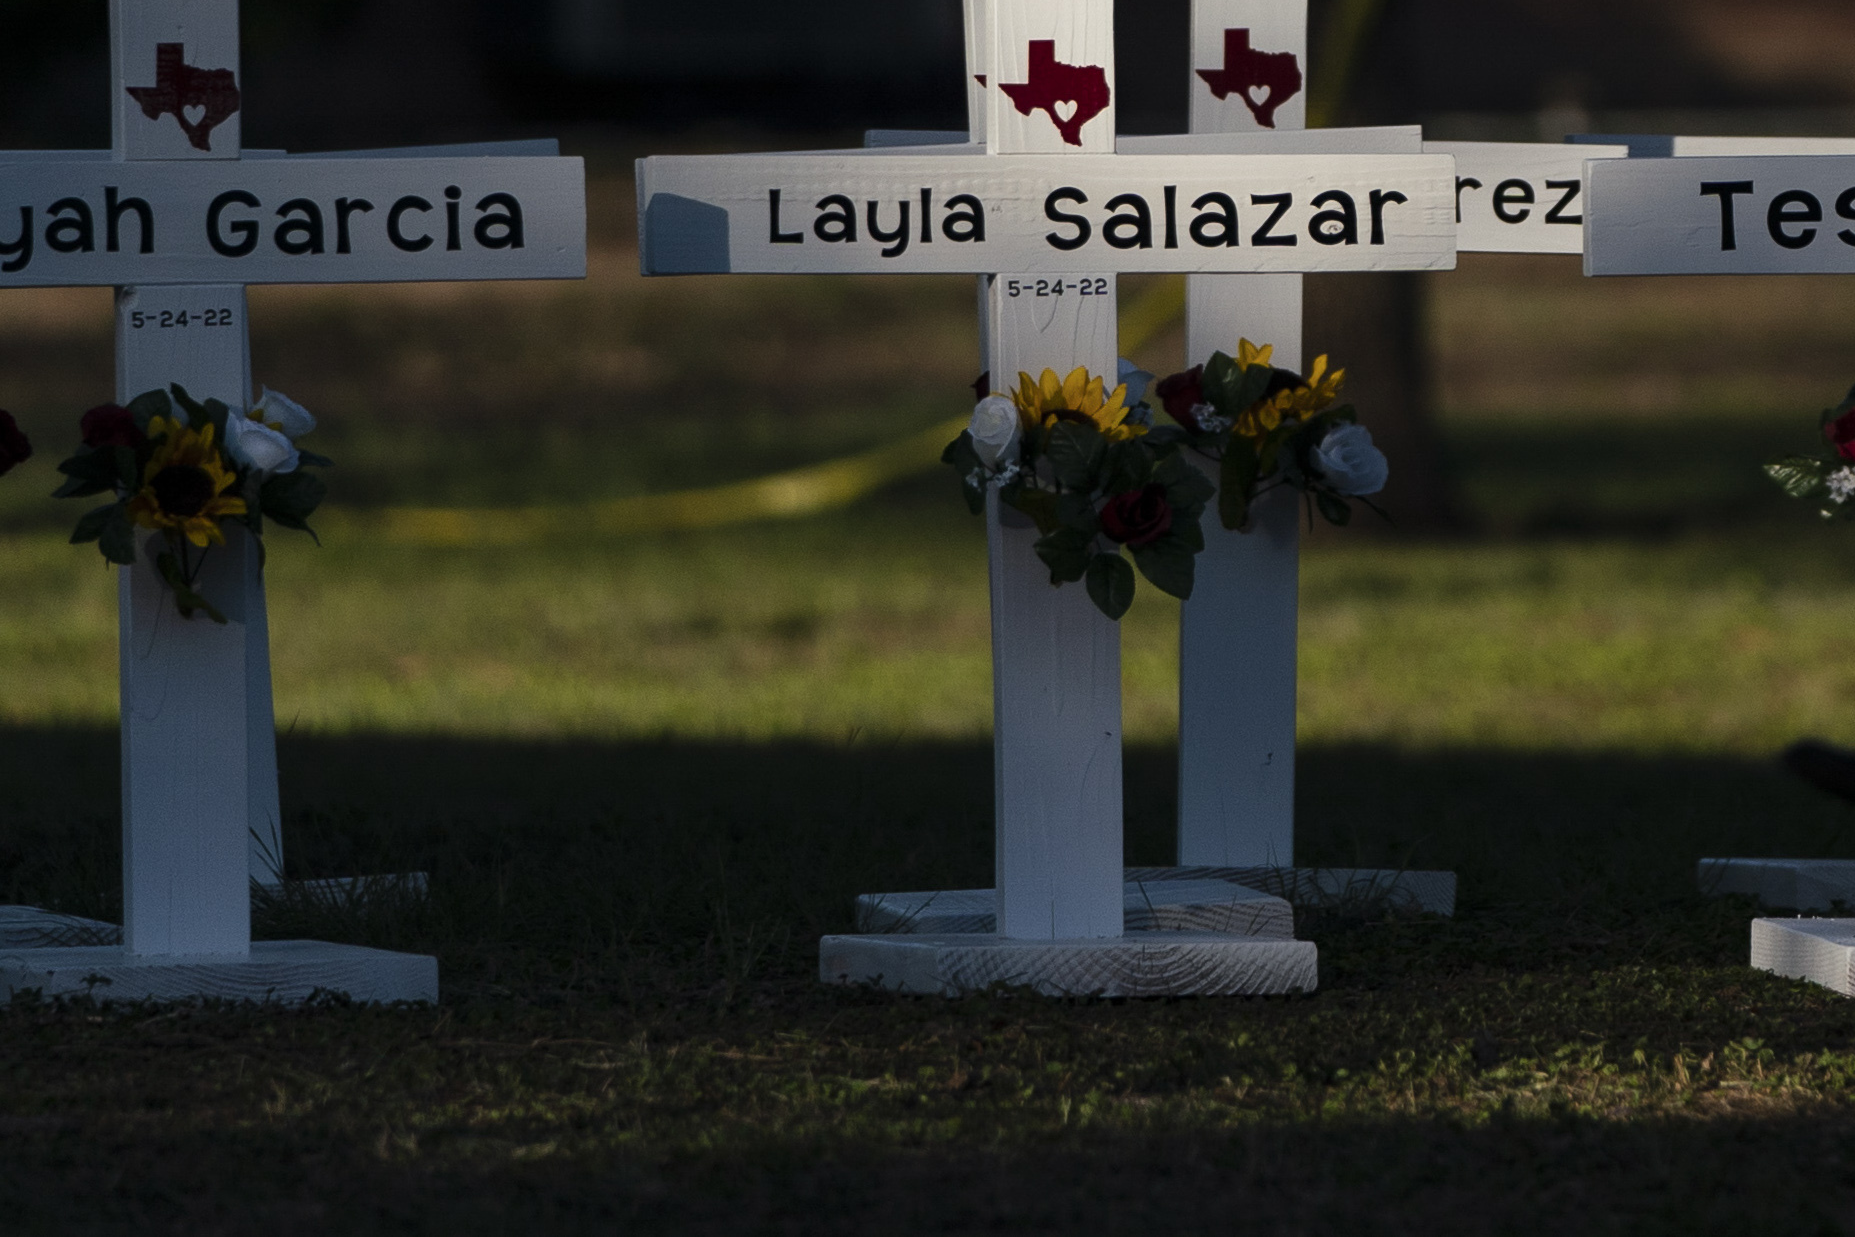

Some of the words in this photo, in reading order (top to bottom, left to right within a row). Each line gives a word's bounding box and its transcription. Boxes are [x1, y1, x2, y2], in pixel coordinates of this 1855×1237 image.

[206, 186, 524, 257] Garcia
[768, 187, 986, 258] Layla
[1044, 185, 1408, 251] Salazar
[1007, 278, 1108, 298] 5-24-22
[131, 308, 233, 329] 5-24-22
